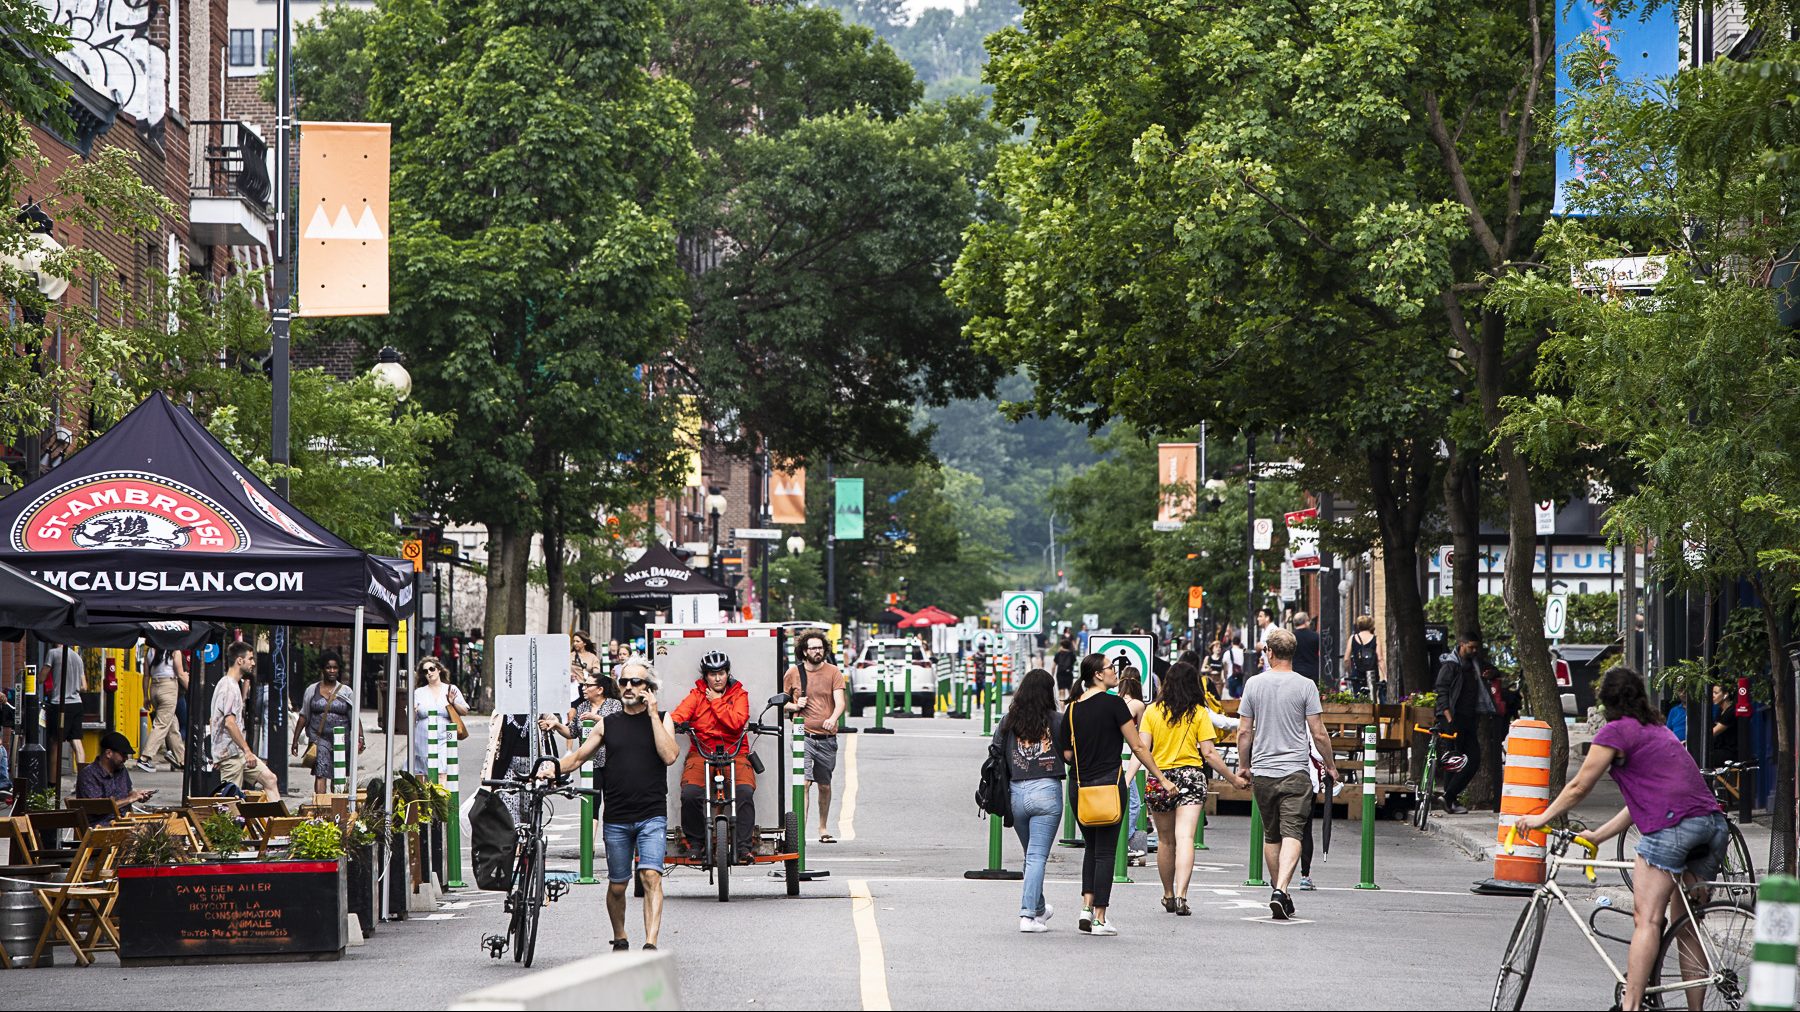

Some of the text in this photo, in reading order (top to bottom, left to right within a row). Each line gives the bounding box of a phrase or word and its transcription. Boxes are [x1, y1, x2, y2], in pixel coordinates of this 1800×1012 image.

[38, 488, 224, 547] ST-AMBROISE
[31, 570, 304, 592] MCAUSLAN.COM
[624, 569, 650, 583] JACK
[193, 884, 206, 893] VA
[210, 893, 226, 901] ON
[204, 909, 281, 920] CONSOMMATION
[227, 920, 273, 929] ANIMALE
